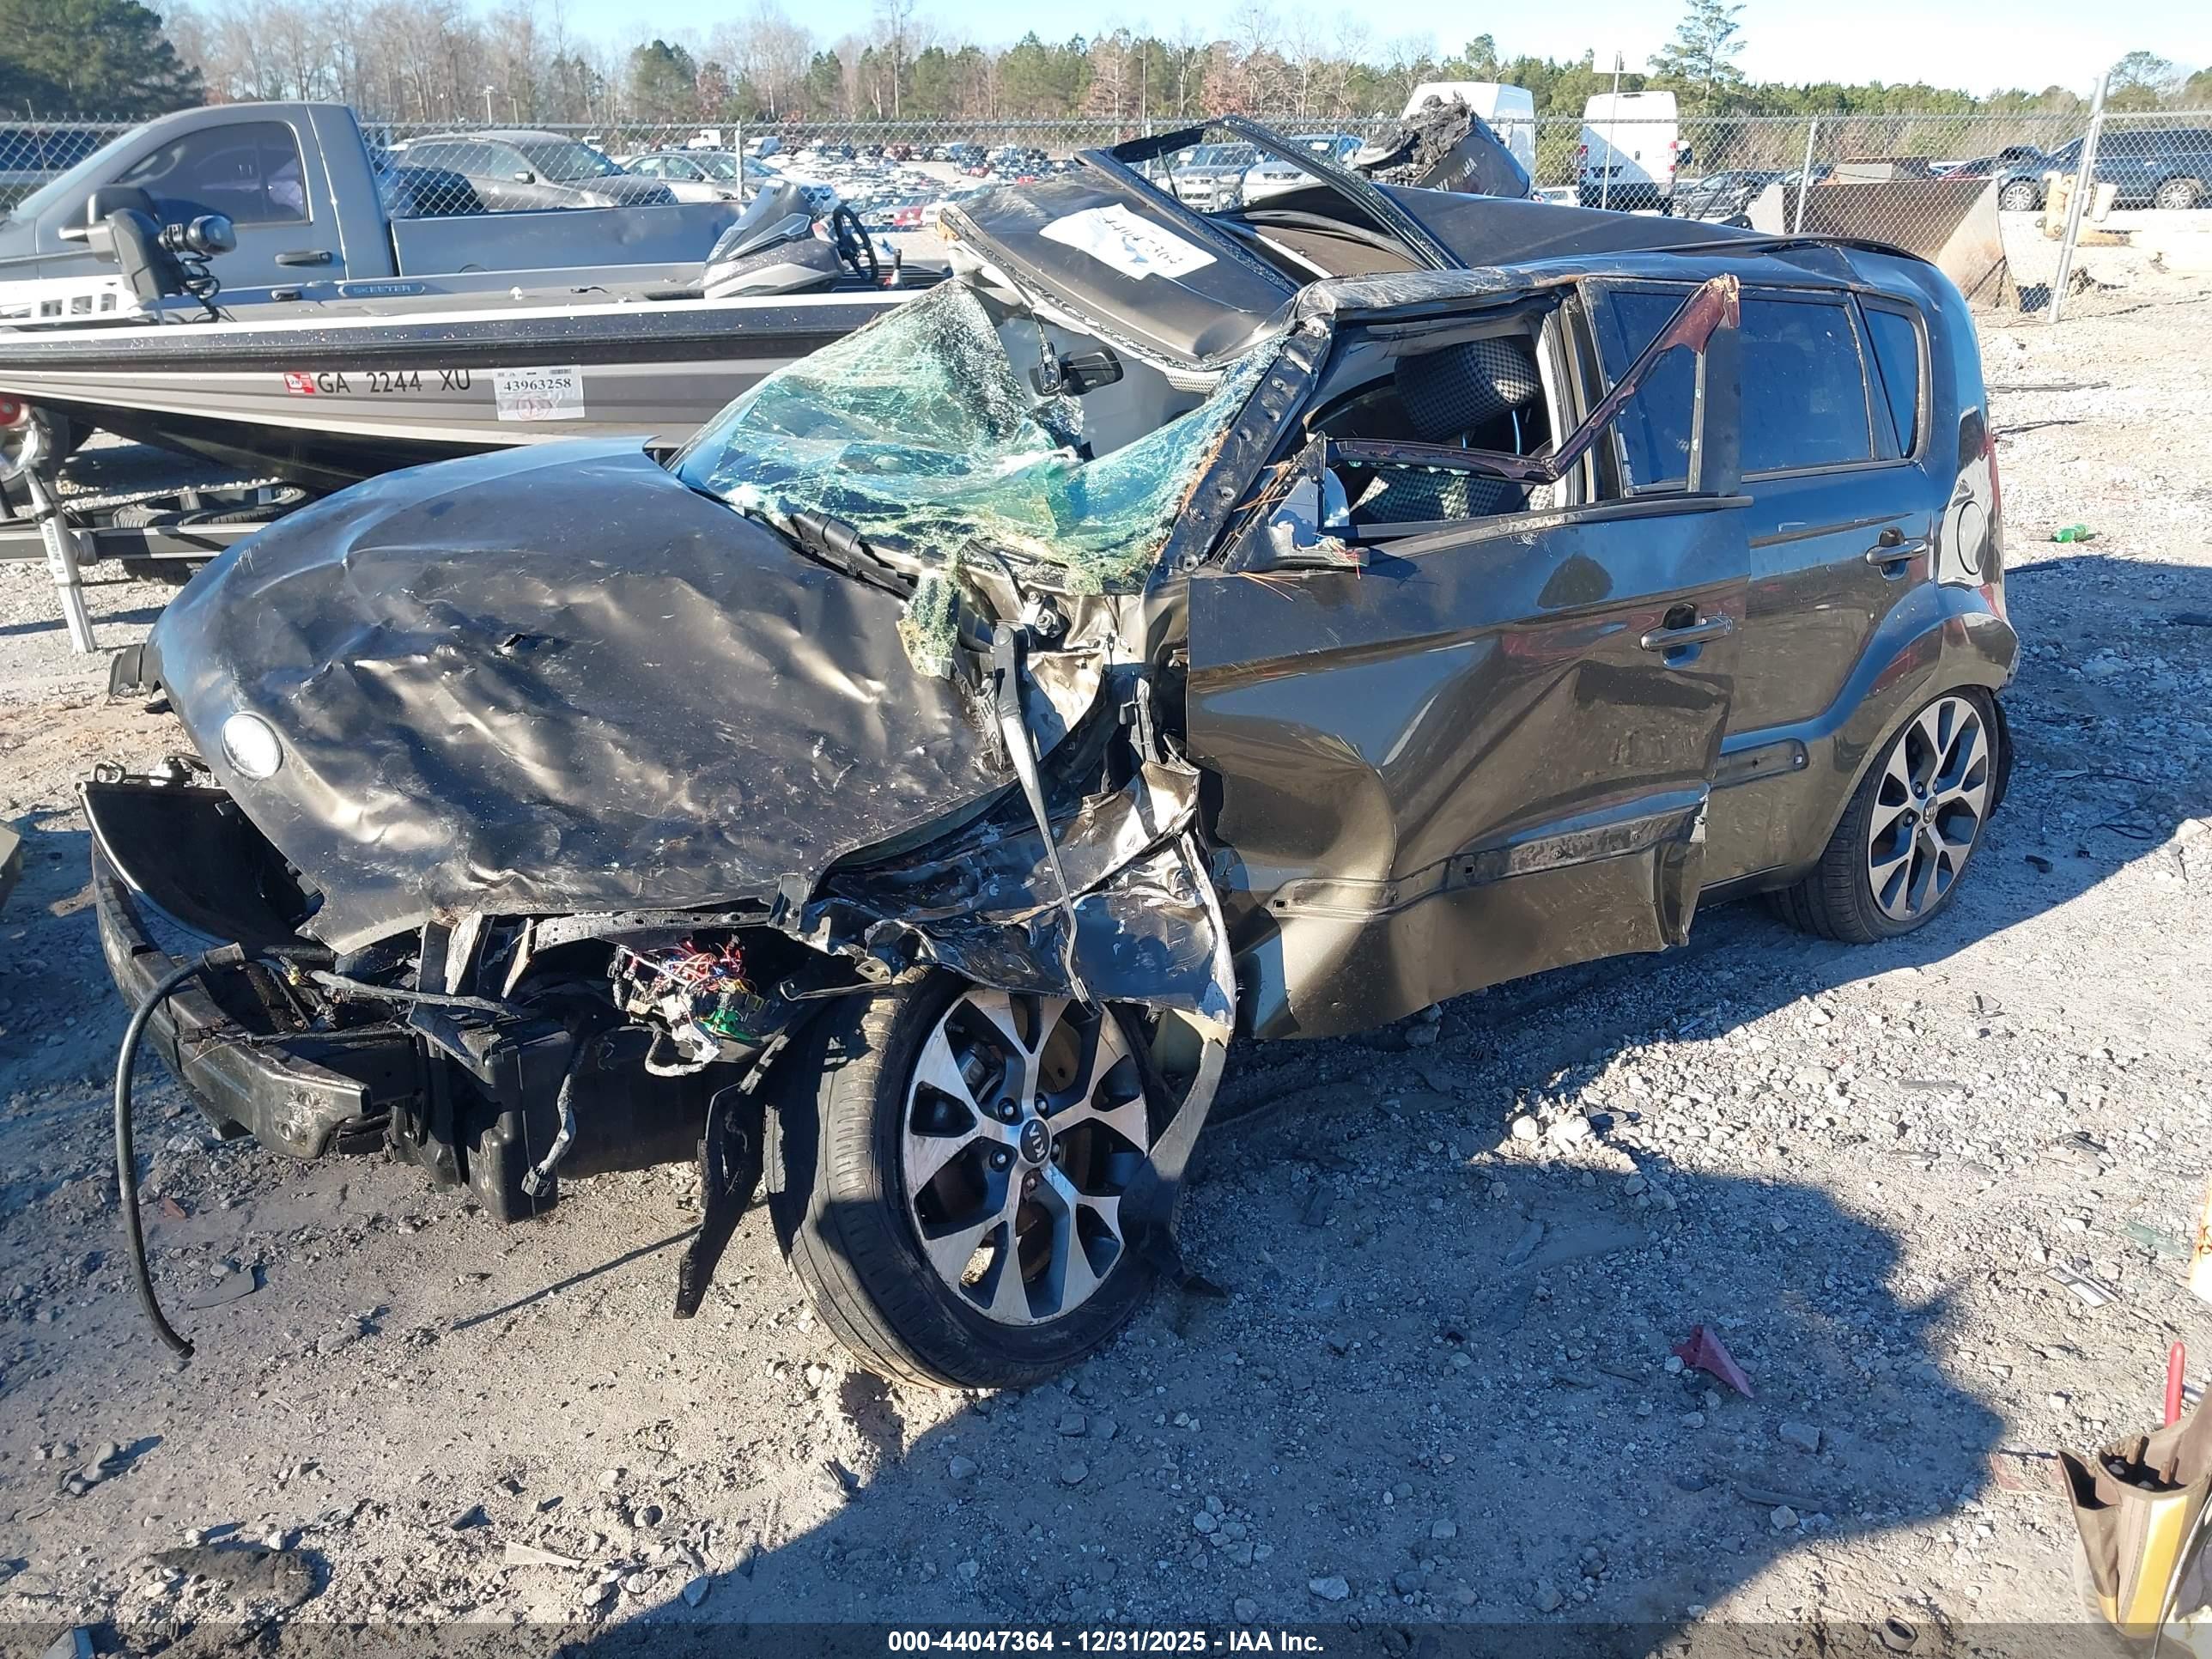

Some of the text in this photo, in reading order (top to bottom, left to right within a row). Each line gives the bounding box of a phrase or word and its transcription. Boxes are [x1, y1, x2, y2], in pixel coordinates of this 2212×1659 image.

[317, 369, 471, 394] GA 2244 XU
[504, 378, 572, 392] 43963258
[1030, 1123, 1046, 1159] KIA
